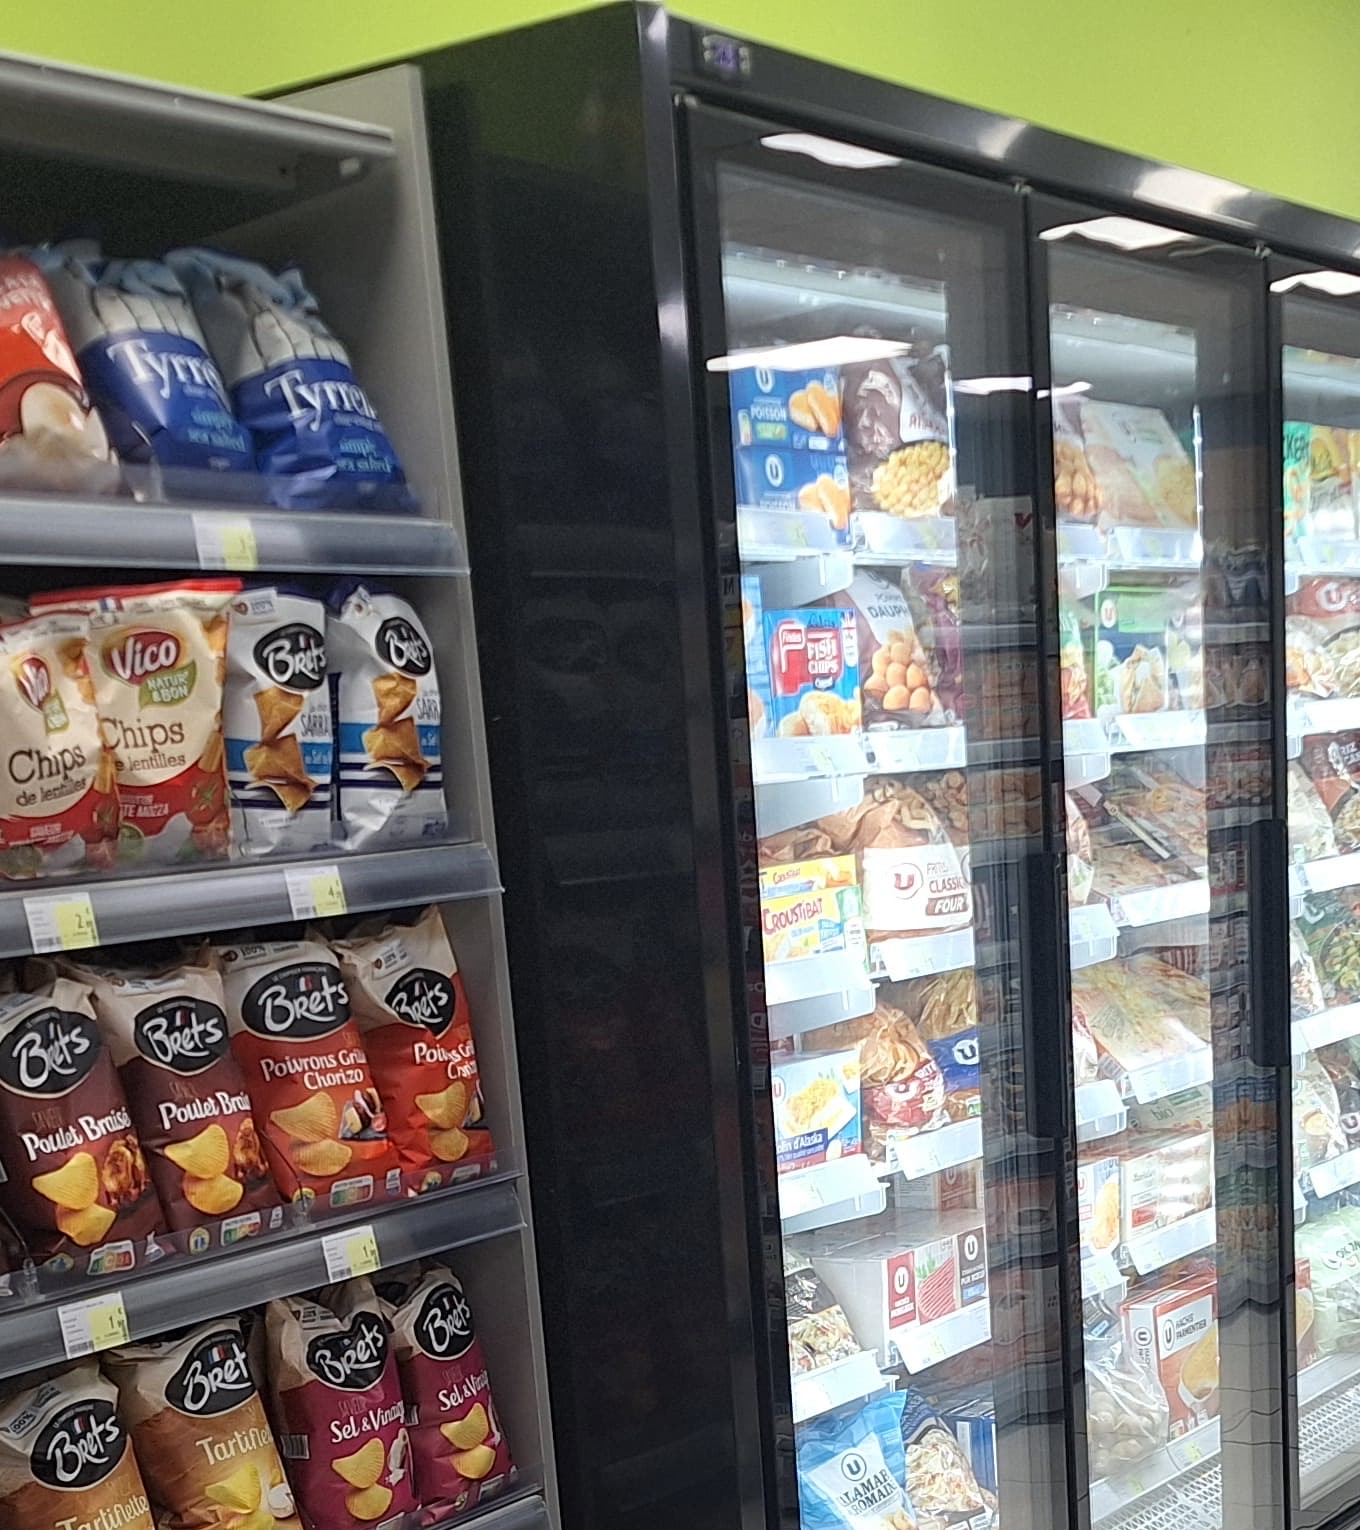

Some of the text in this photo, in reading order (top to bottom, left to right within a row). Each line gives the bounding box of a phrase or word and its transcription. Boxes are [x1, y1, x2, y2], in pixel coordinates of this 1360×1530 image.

[265, 369, 377, 431] Tyrrel
[750, 405, 787, 422] POISSON
[110, 633, 181, 681] Vico
[265, 635, 327, 683] Brets
[388, 630, 427, 668] Brets
[808, 655, 838, 675] CHIPS
[8, 744, 86, 788] Chips
[127, 753, 186, 771] lentilles
[763, 898, 823, 935] CROUSTIBAT
[935, 898, 964, 914] FOUR
[258, 981, 350, 1032] Brets
[143, 1012, 224, 1069] Brets
[259, 1051, 337, 1082] Poivrons
[303, 1067, 364, 1091] Chorizo
[22, 1104, 132, 1163] Poulet Braisé
[314, 1322, 385, 1385] Brets
[330, 1415, 362, 1445] Sel
[369, 1400, 405, 1432] Vinaig
[46, 1412, 121, 1483] Brets
